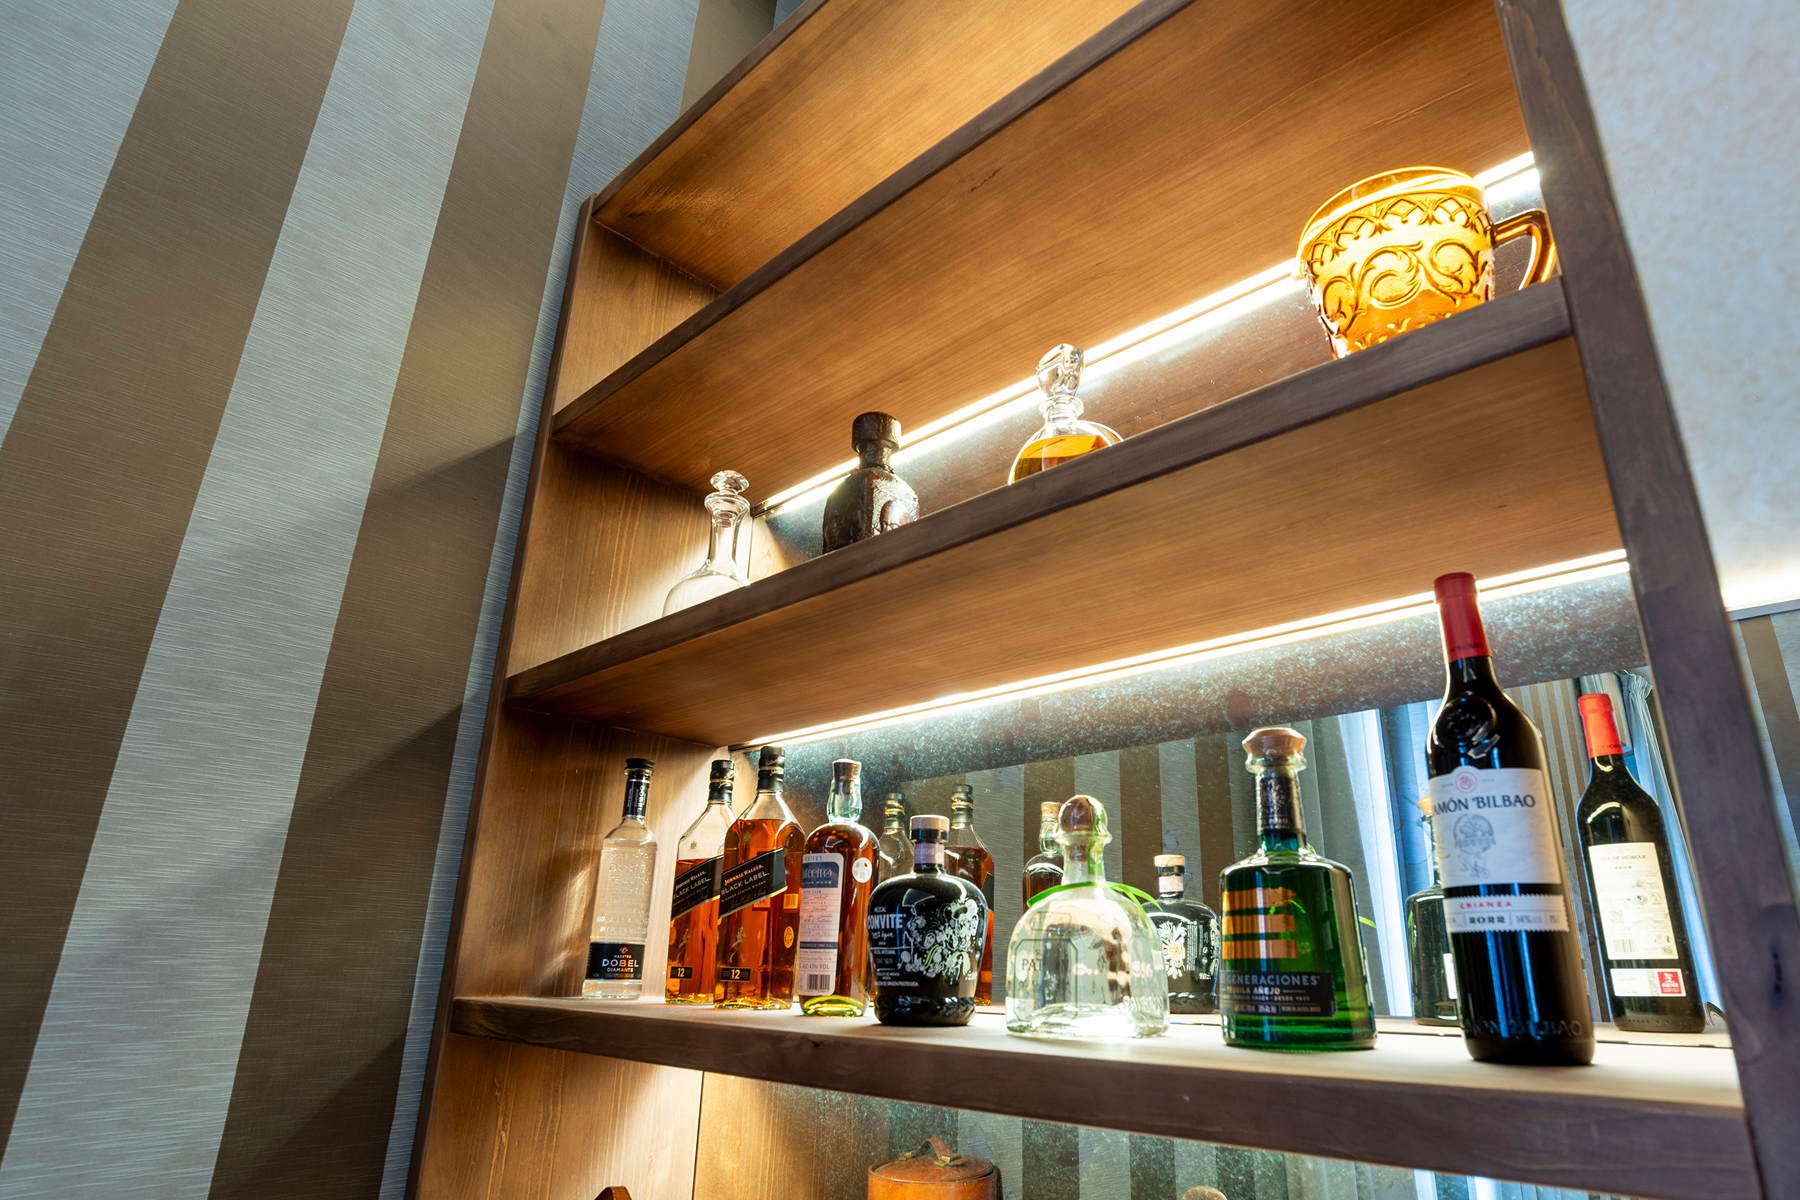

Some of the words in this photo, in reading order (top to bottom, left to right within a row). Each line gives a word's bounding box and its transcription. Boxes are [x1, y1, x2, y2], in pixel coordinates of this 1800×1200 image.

[1432, 797, 1469, 815] AMÓN
[1472, 794, 1536, 809] BILBAO
[690, 876, 709, 890] LABEL
[720, 881, 744, 896] BLACK
[744, 871, 768, 885] LABEL
[1459, 900, 1513, 909] CRIANZA
[1468, 915, 1506, 925] 2022
[601, 958, 640, 968] DOBEL
[677, 967, 686, 978] 12
[731, 969, 741, 980] 12
[1227, 974, 1318, 986] GENERACIONES
[1253, 986, 1281, 995] AÑEJO
